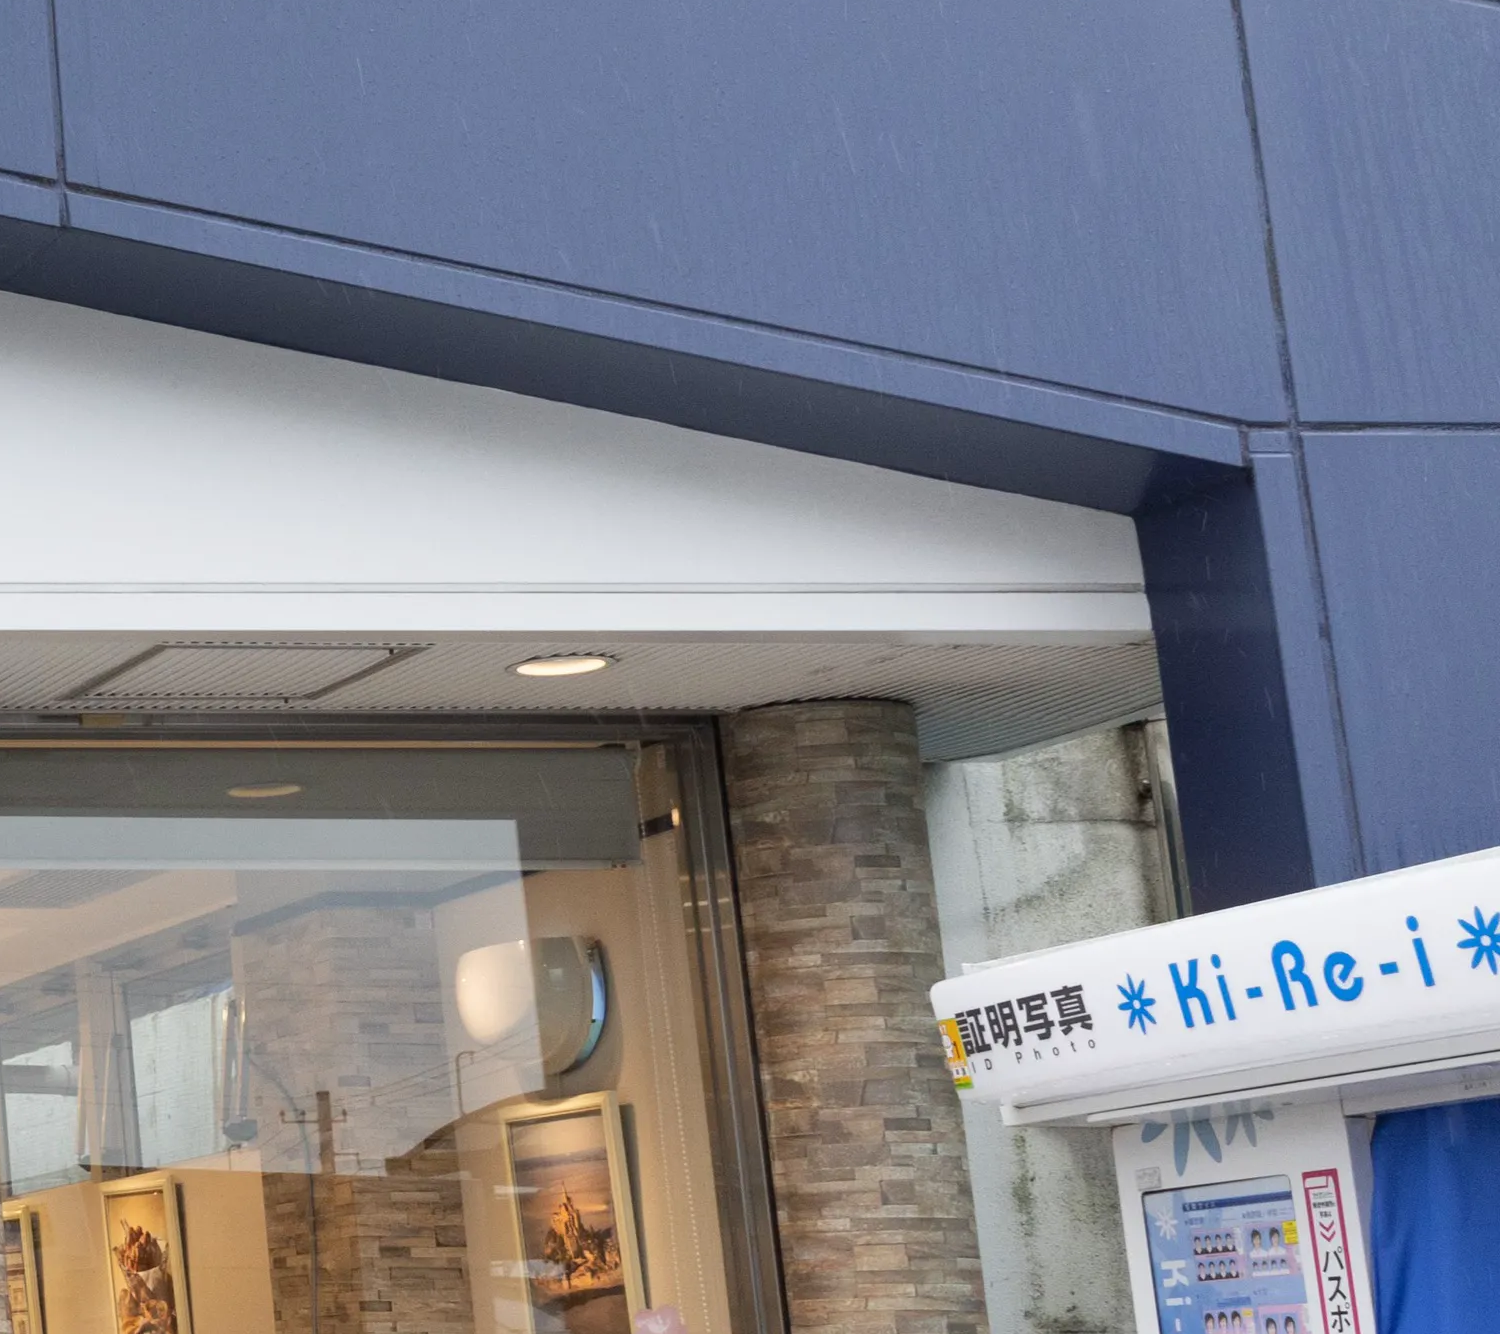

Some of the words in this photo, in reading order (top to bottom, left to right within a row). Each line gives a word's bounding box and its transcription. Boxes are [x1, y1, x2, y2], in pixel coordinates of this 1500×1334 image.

[955, 983, 1095, 1058] 証明写真
[1167, 914, 1436, 1029] Ki-Re-i
[1015, 1038, 1097, 1065] Photo
